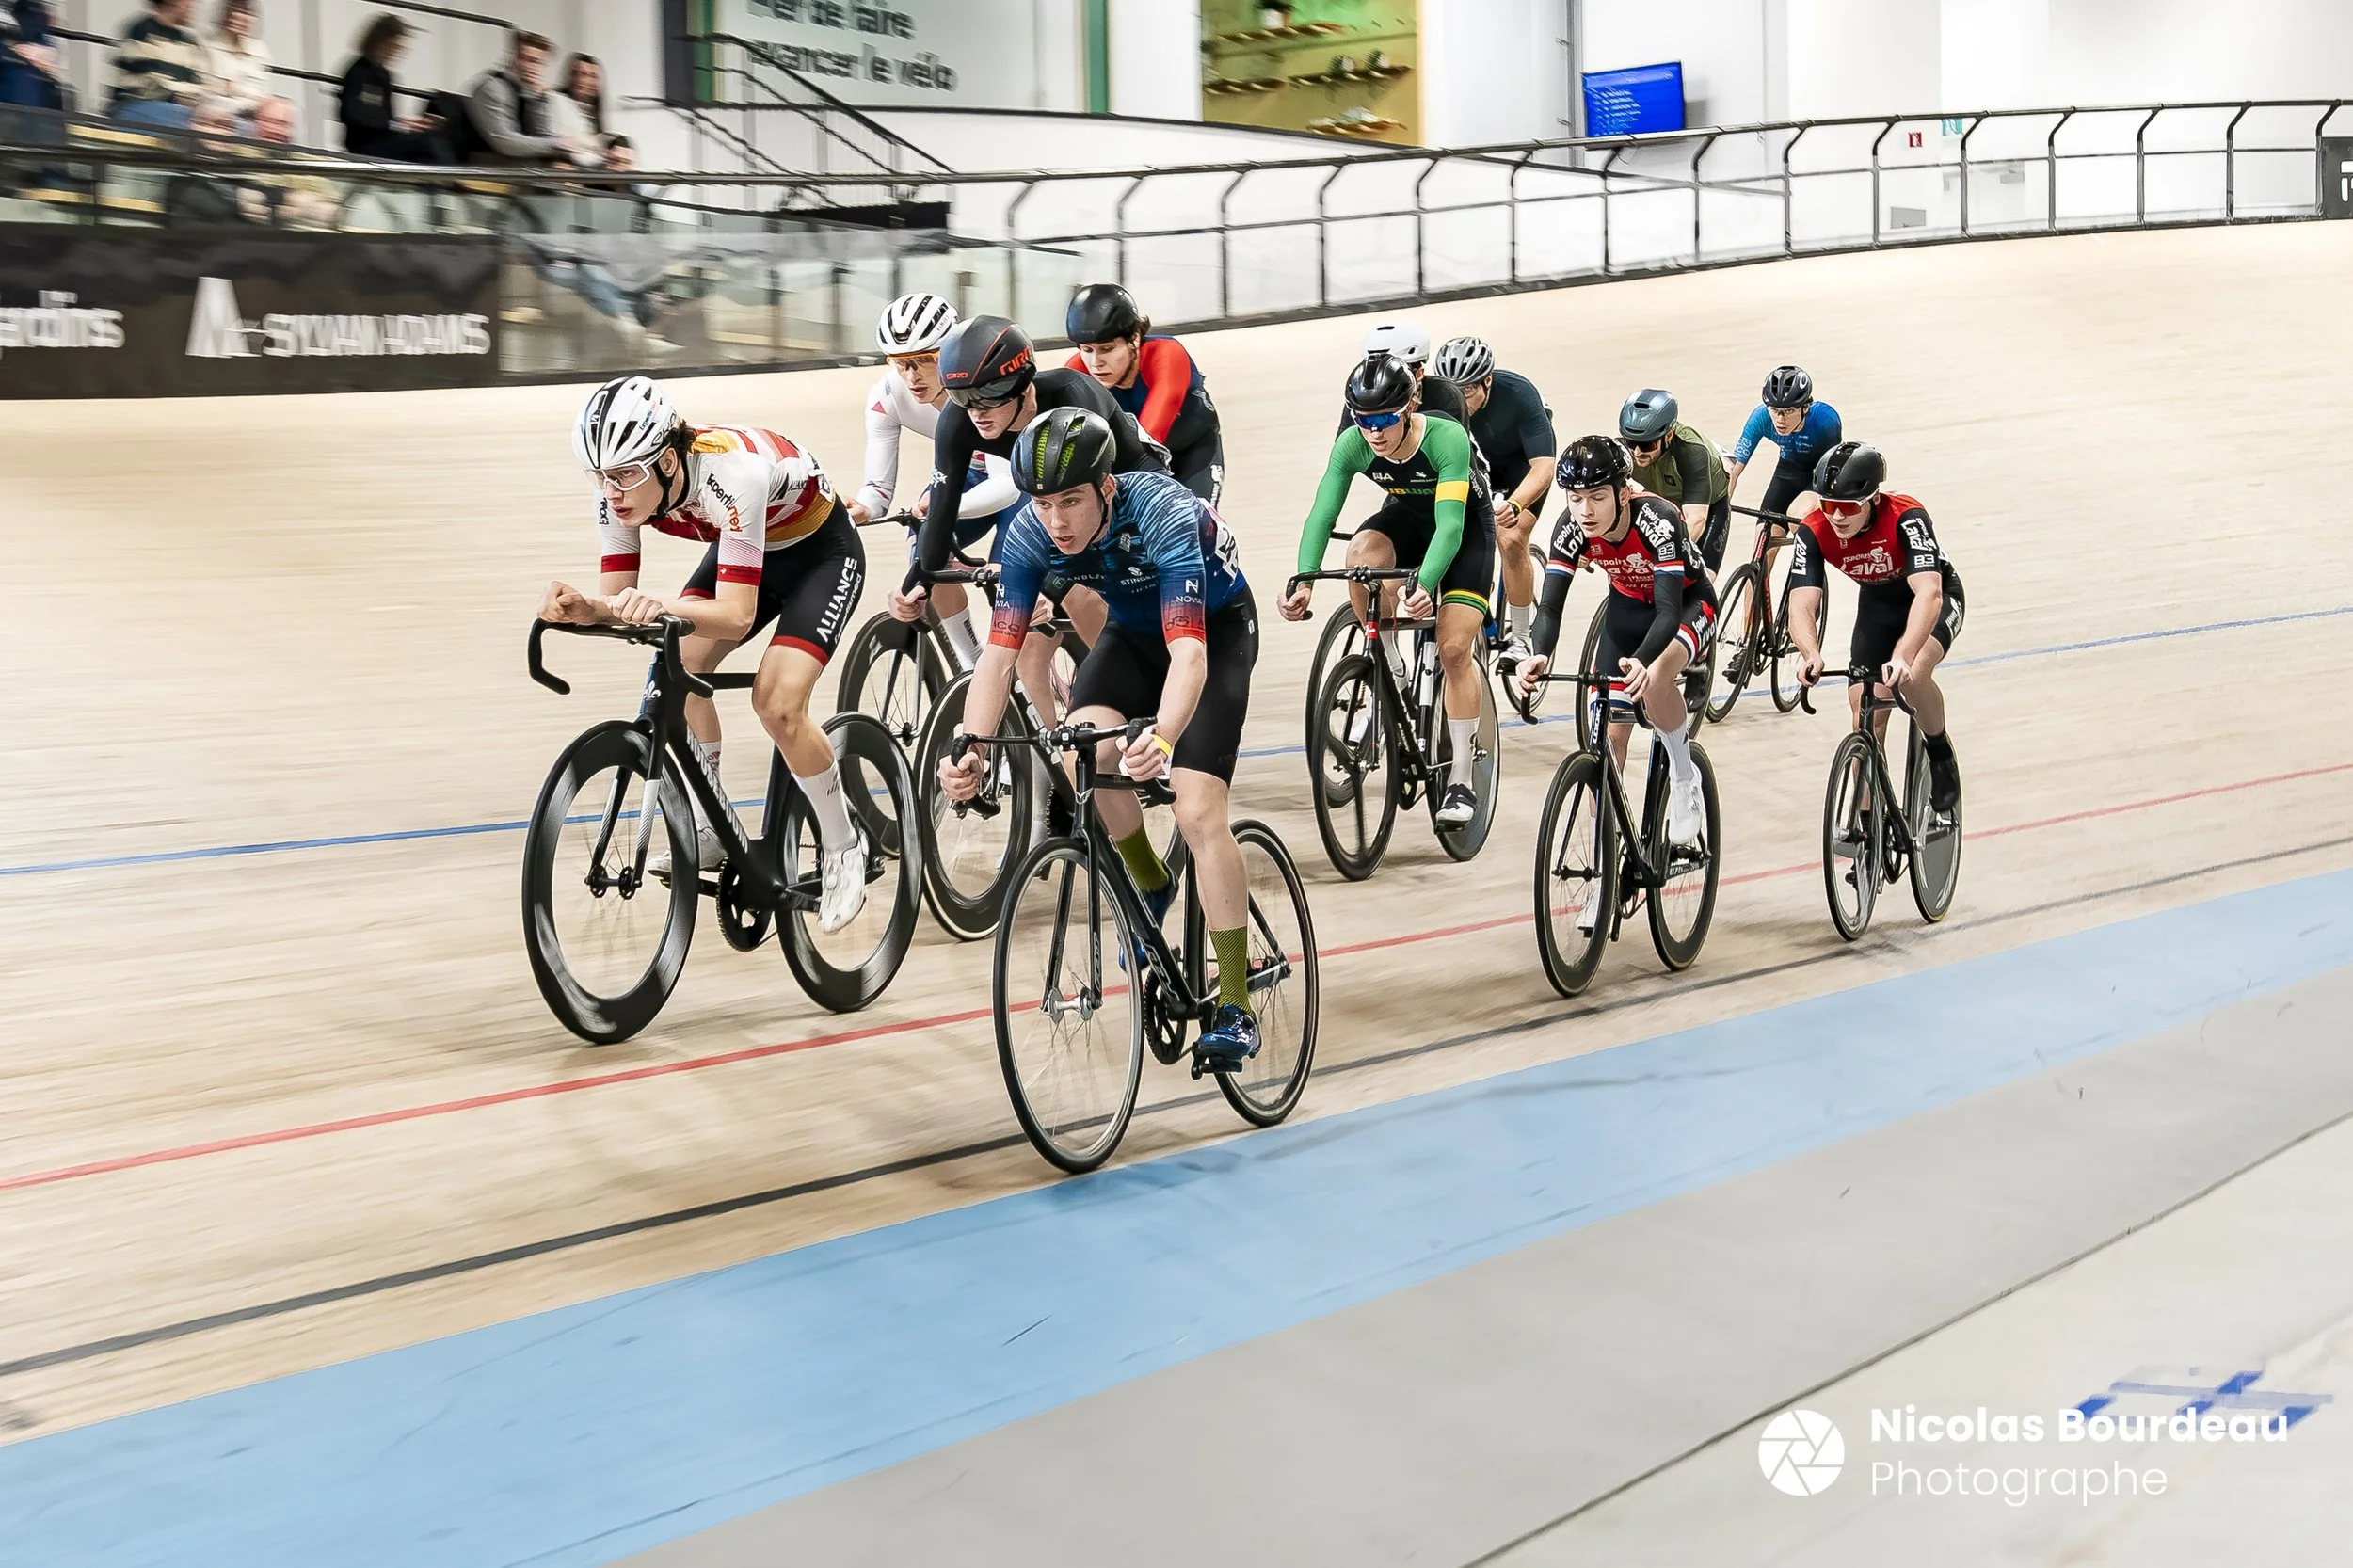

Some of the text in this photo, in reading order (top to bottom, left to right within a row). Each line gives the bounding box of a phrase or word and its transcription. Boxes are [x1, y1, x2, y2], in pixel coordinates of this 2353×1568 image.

[383, 313, 491, 356] ADAMS
[1561, 530, 1583, 559] Lav
[817, 557, 857, 643] ALLIANCE
